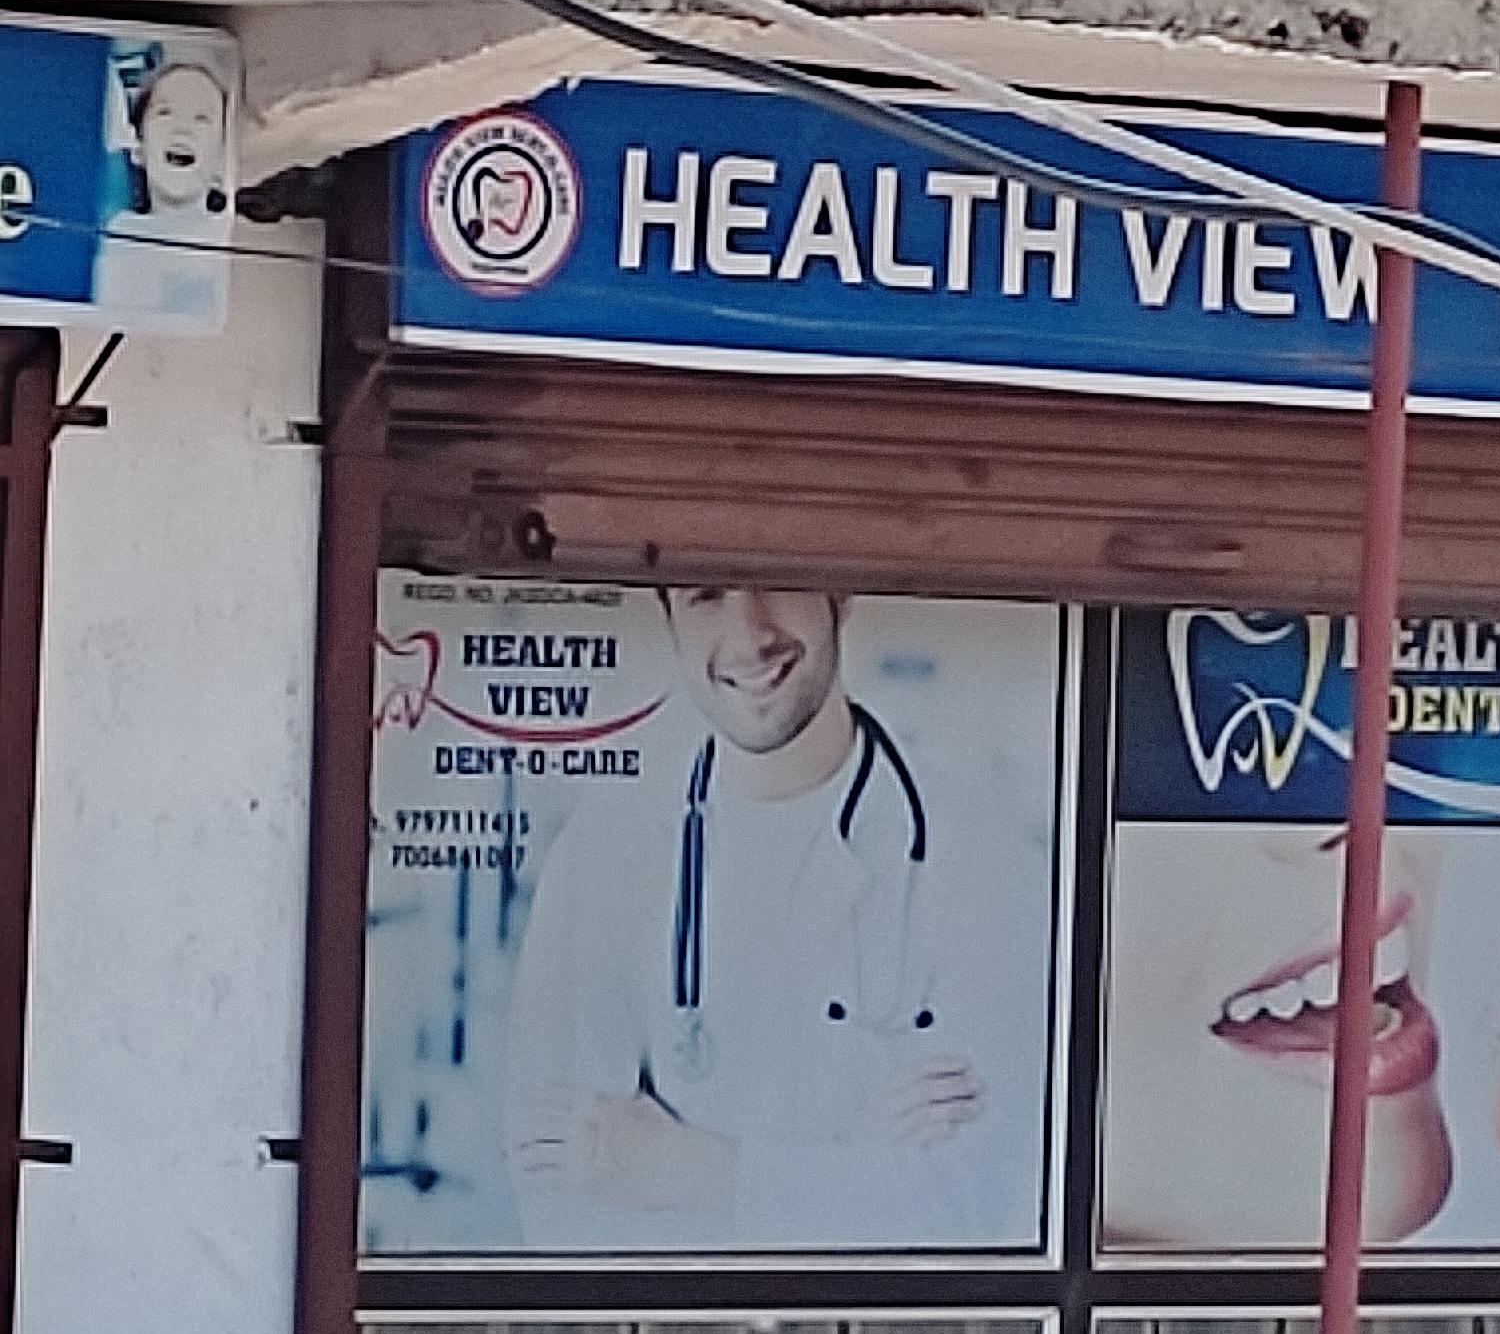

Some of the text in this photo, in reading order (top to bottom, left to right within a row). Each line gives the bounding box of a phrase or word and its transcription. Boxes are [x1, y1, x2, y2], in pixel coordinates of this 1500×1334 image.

[618, 148, 1077, 300] HEALTH
[1121, 208, 1379, 323] VIEW
[462, 634, 617, 668] HEALTH
[487, 685, 590, 717] VIEW
